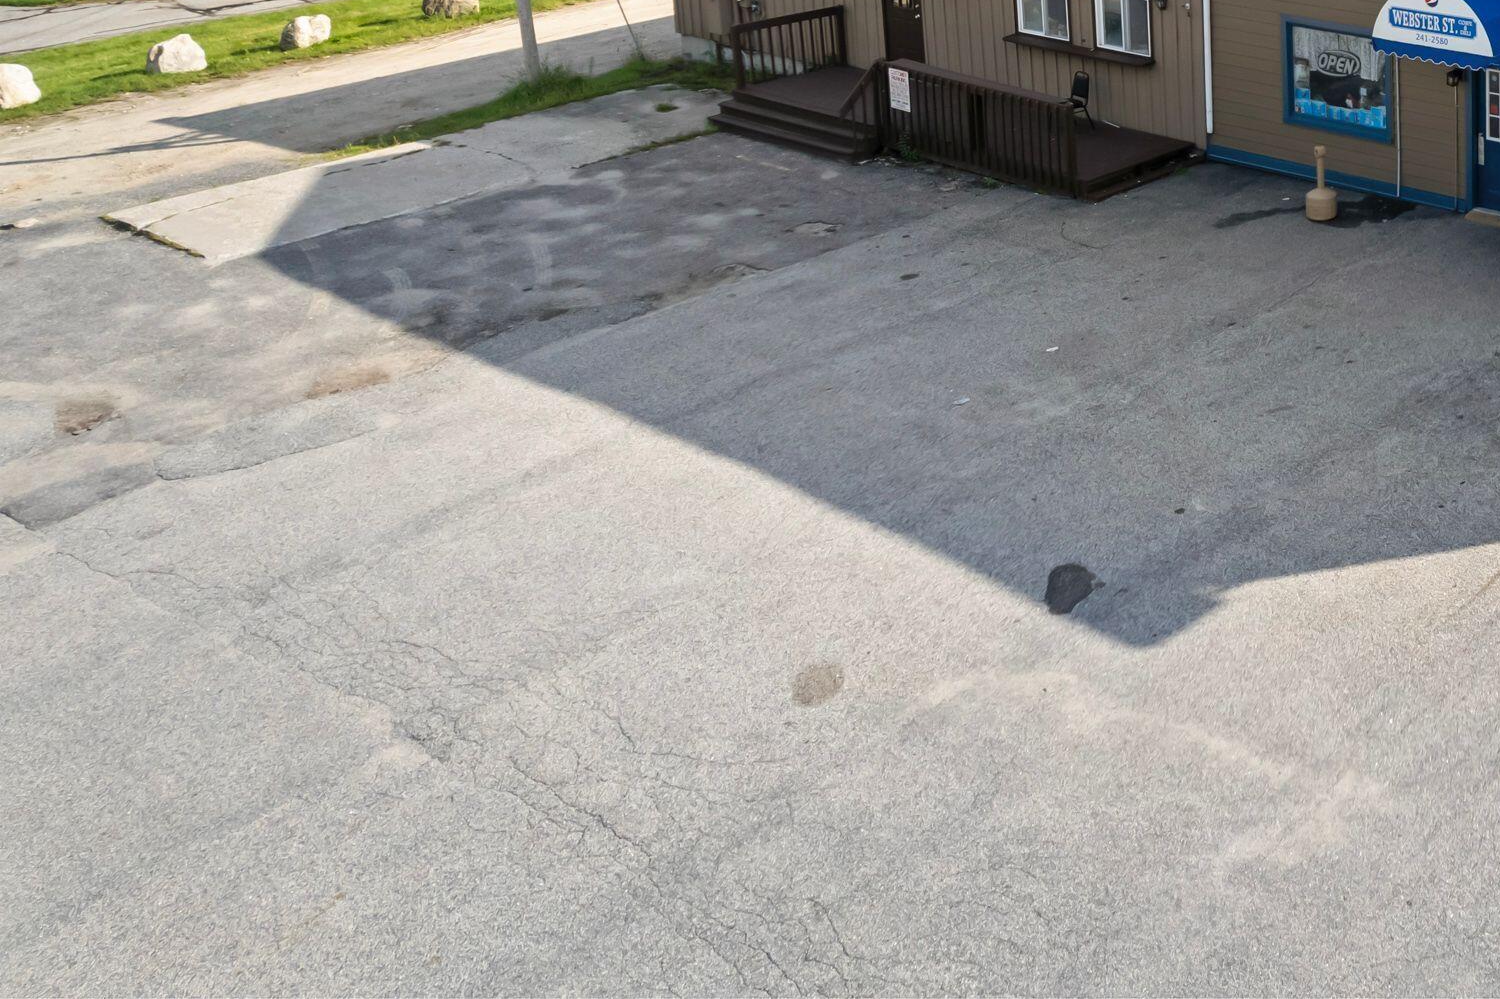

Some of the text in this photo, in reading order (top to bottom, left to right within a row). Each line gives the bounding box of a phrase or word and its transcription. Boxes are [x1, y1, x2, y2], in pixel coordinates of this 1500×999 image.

[1392, 9, 1458, 34] WEBSTER ST.
[1416, 33, 1449, 46] 241-2580
[1319, 53, 1356, 75] OPEN
